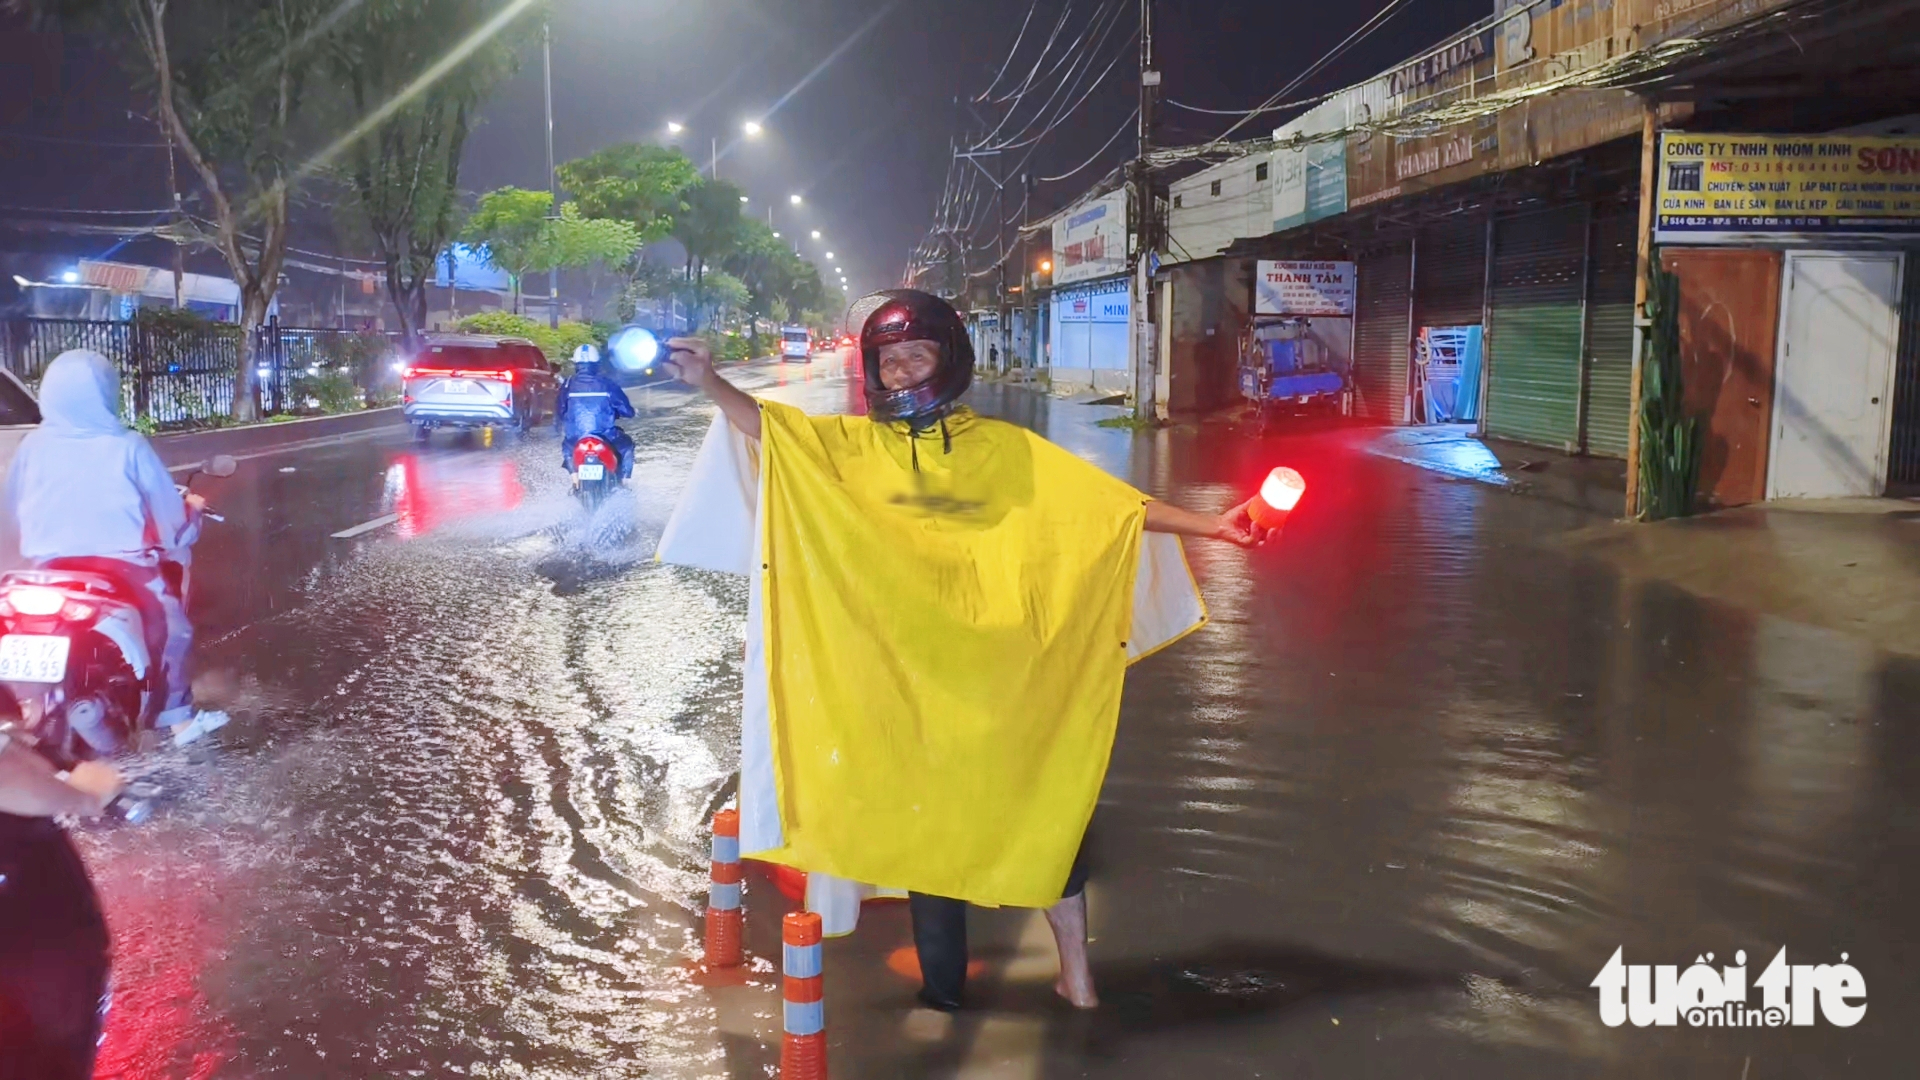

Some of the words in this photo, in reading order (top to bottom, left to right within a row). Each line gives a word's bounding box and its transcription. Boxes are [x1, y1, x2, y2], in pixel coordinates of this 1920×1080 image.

[1667, 139, 1704, 156] CÔNG
[1708, 142, 1725, 156] TY
[1731, 142, 1768, 156] TNHH
[1266, 272, 1311, 284] THANH
